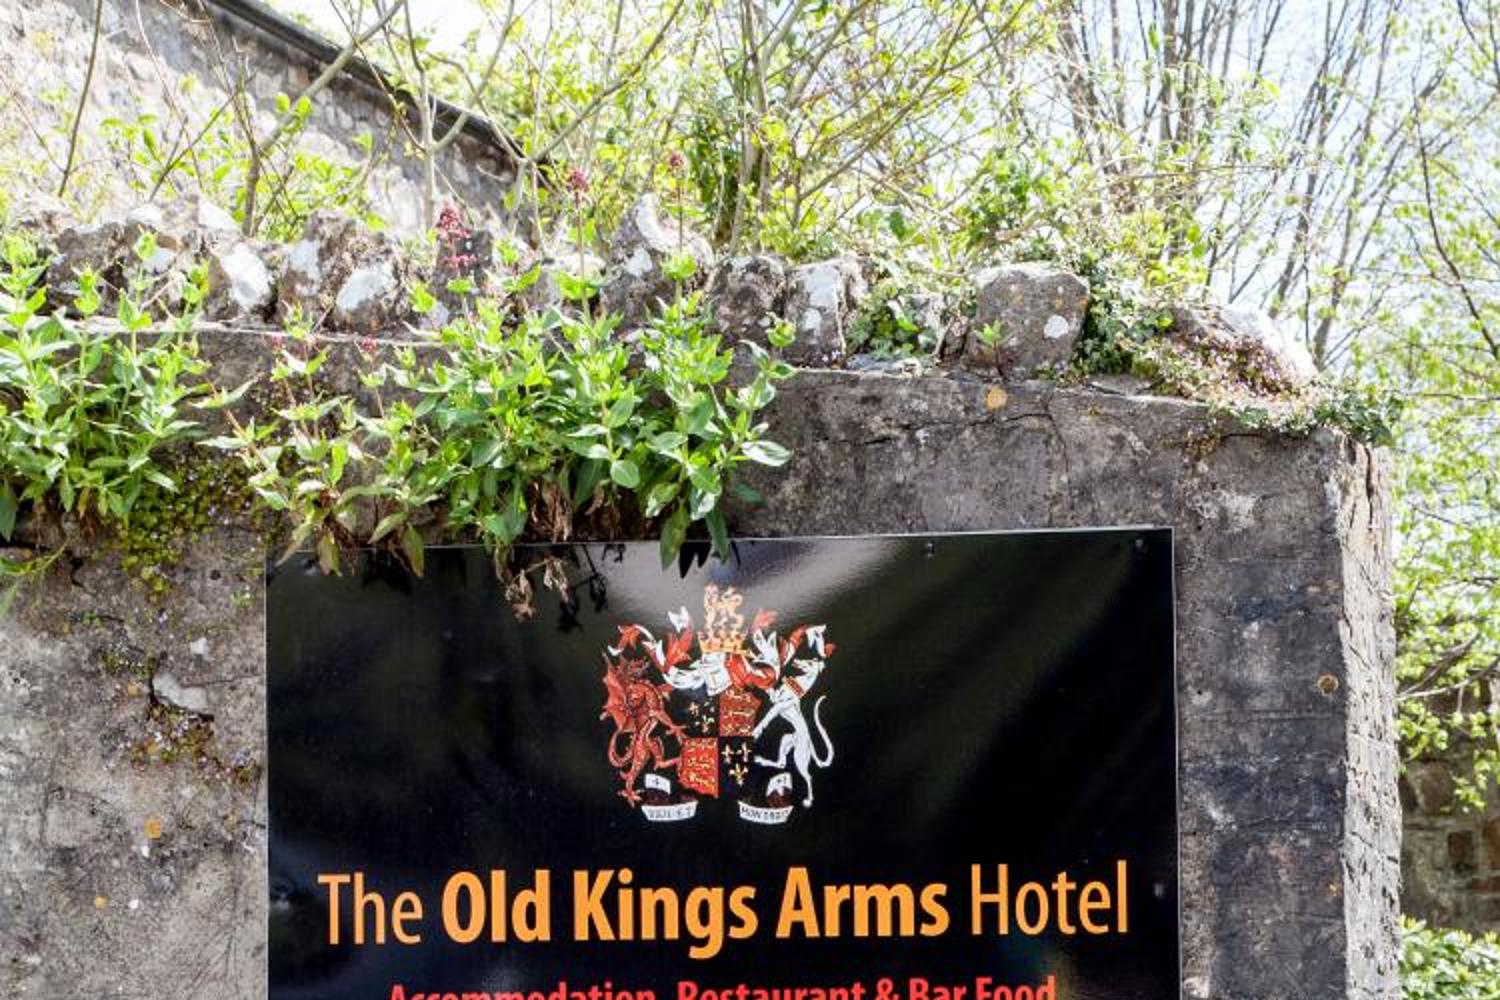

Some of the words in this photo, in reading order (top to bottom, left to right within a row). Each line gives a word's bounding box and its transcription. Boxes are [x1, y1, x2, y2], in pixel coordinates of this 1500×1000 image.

[319, 871, 423, 945] The
[441, 869, 551, 944] Old
[573, 867, 759, 959] Kings
[775, 867, 950, 938] Arms
[971, 863, 1128, 935] Hotel
